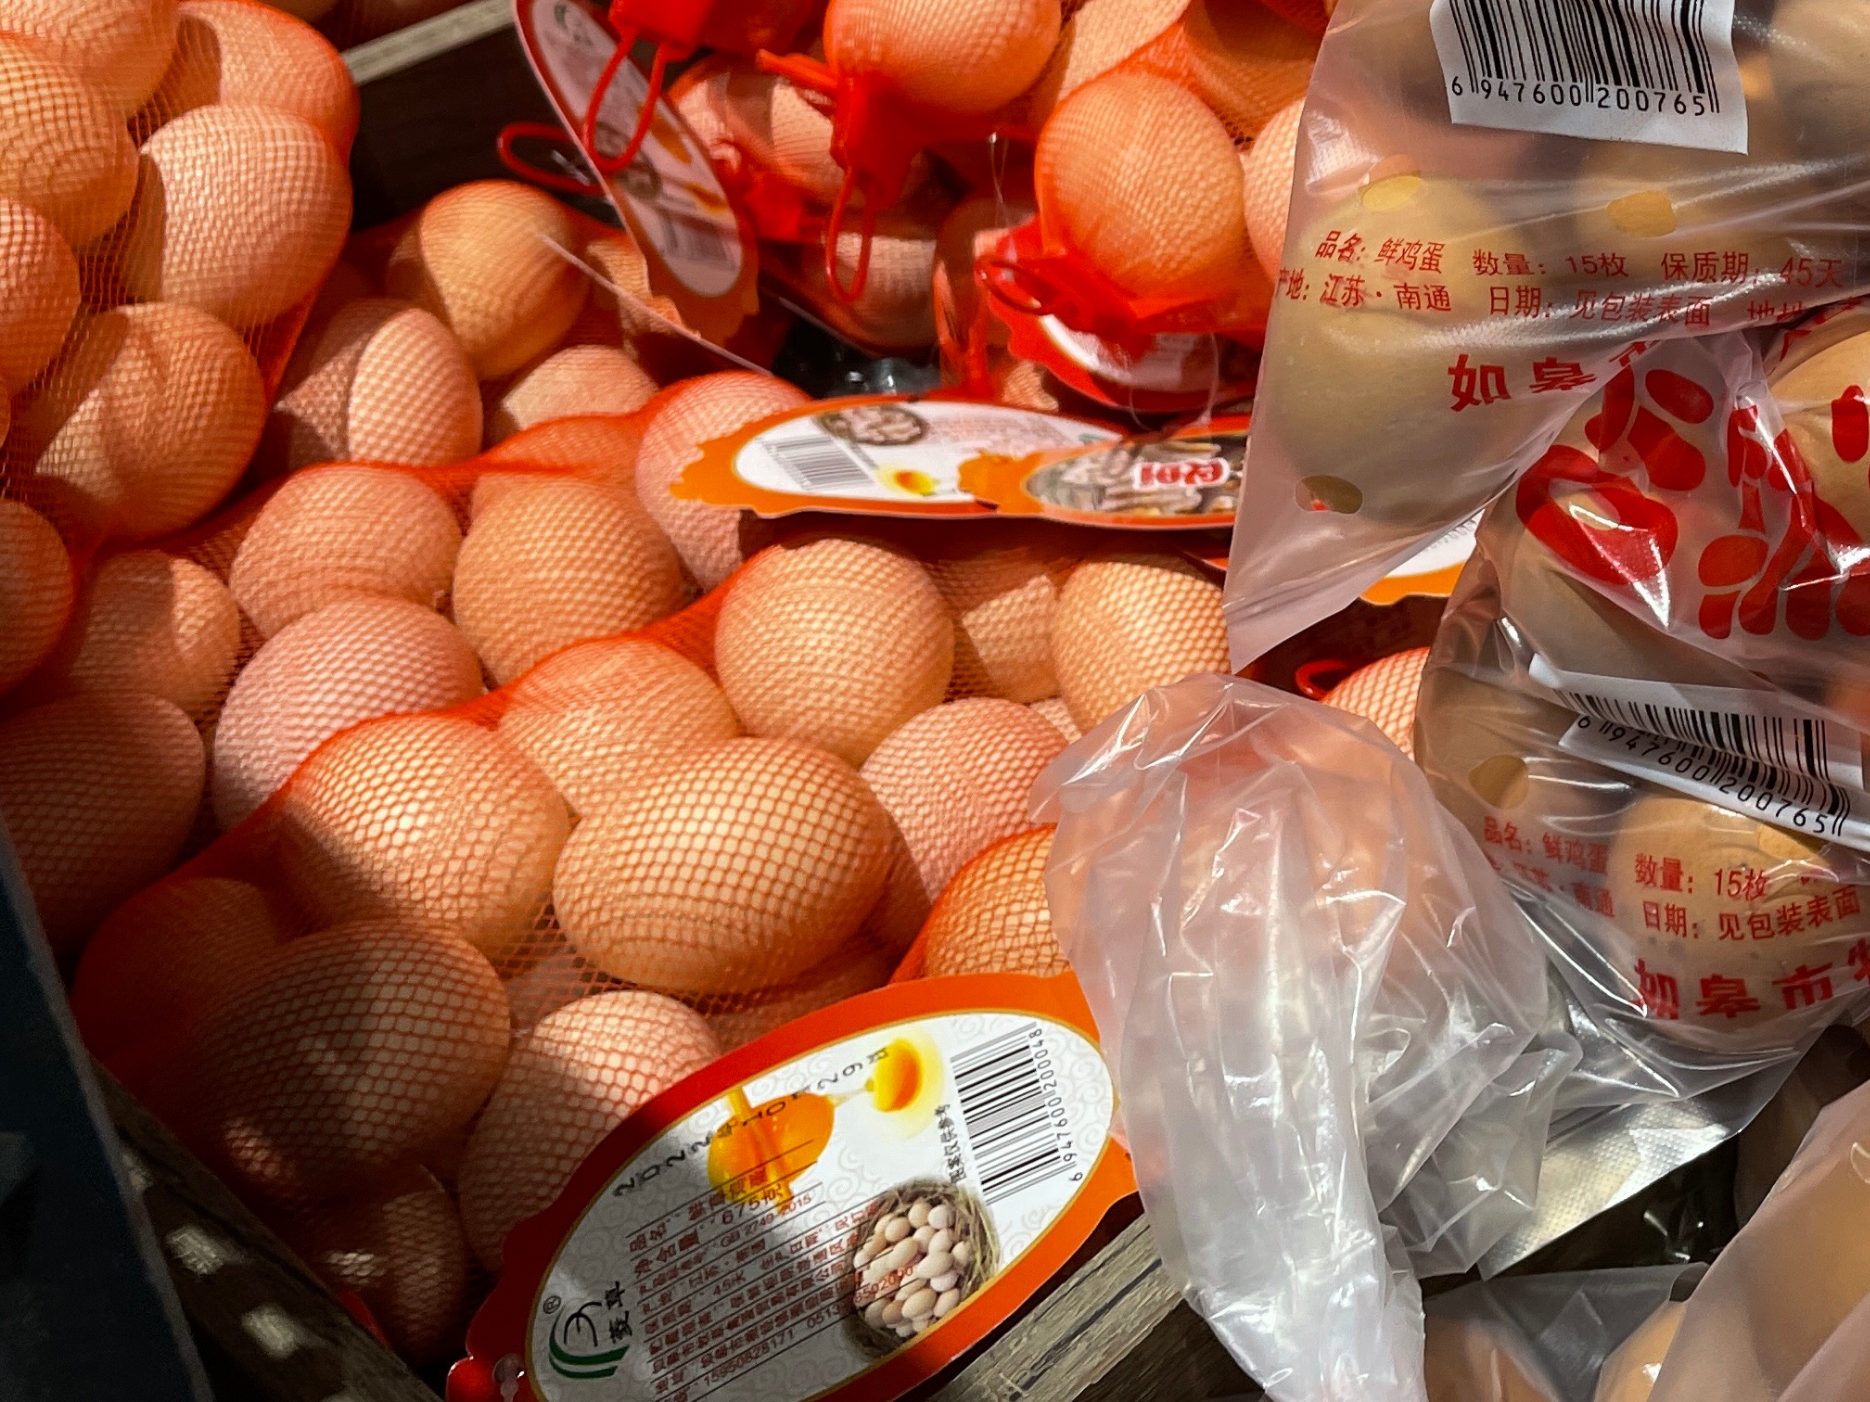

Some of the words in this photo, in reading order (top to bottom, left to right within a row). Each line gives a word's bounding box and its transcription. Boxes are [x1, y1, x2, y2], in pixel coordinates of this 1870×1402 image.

[1315, 229, 1446, 274] 品名：鲜鸡蛋
[1473, 249, 1630, 278] 数量：15枚
